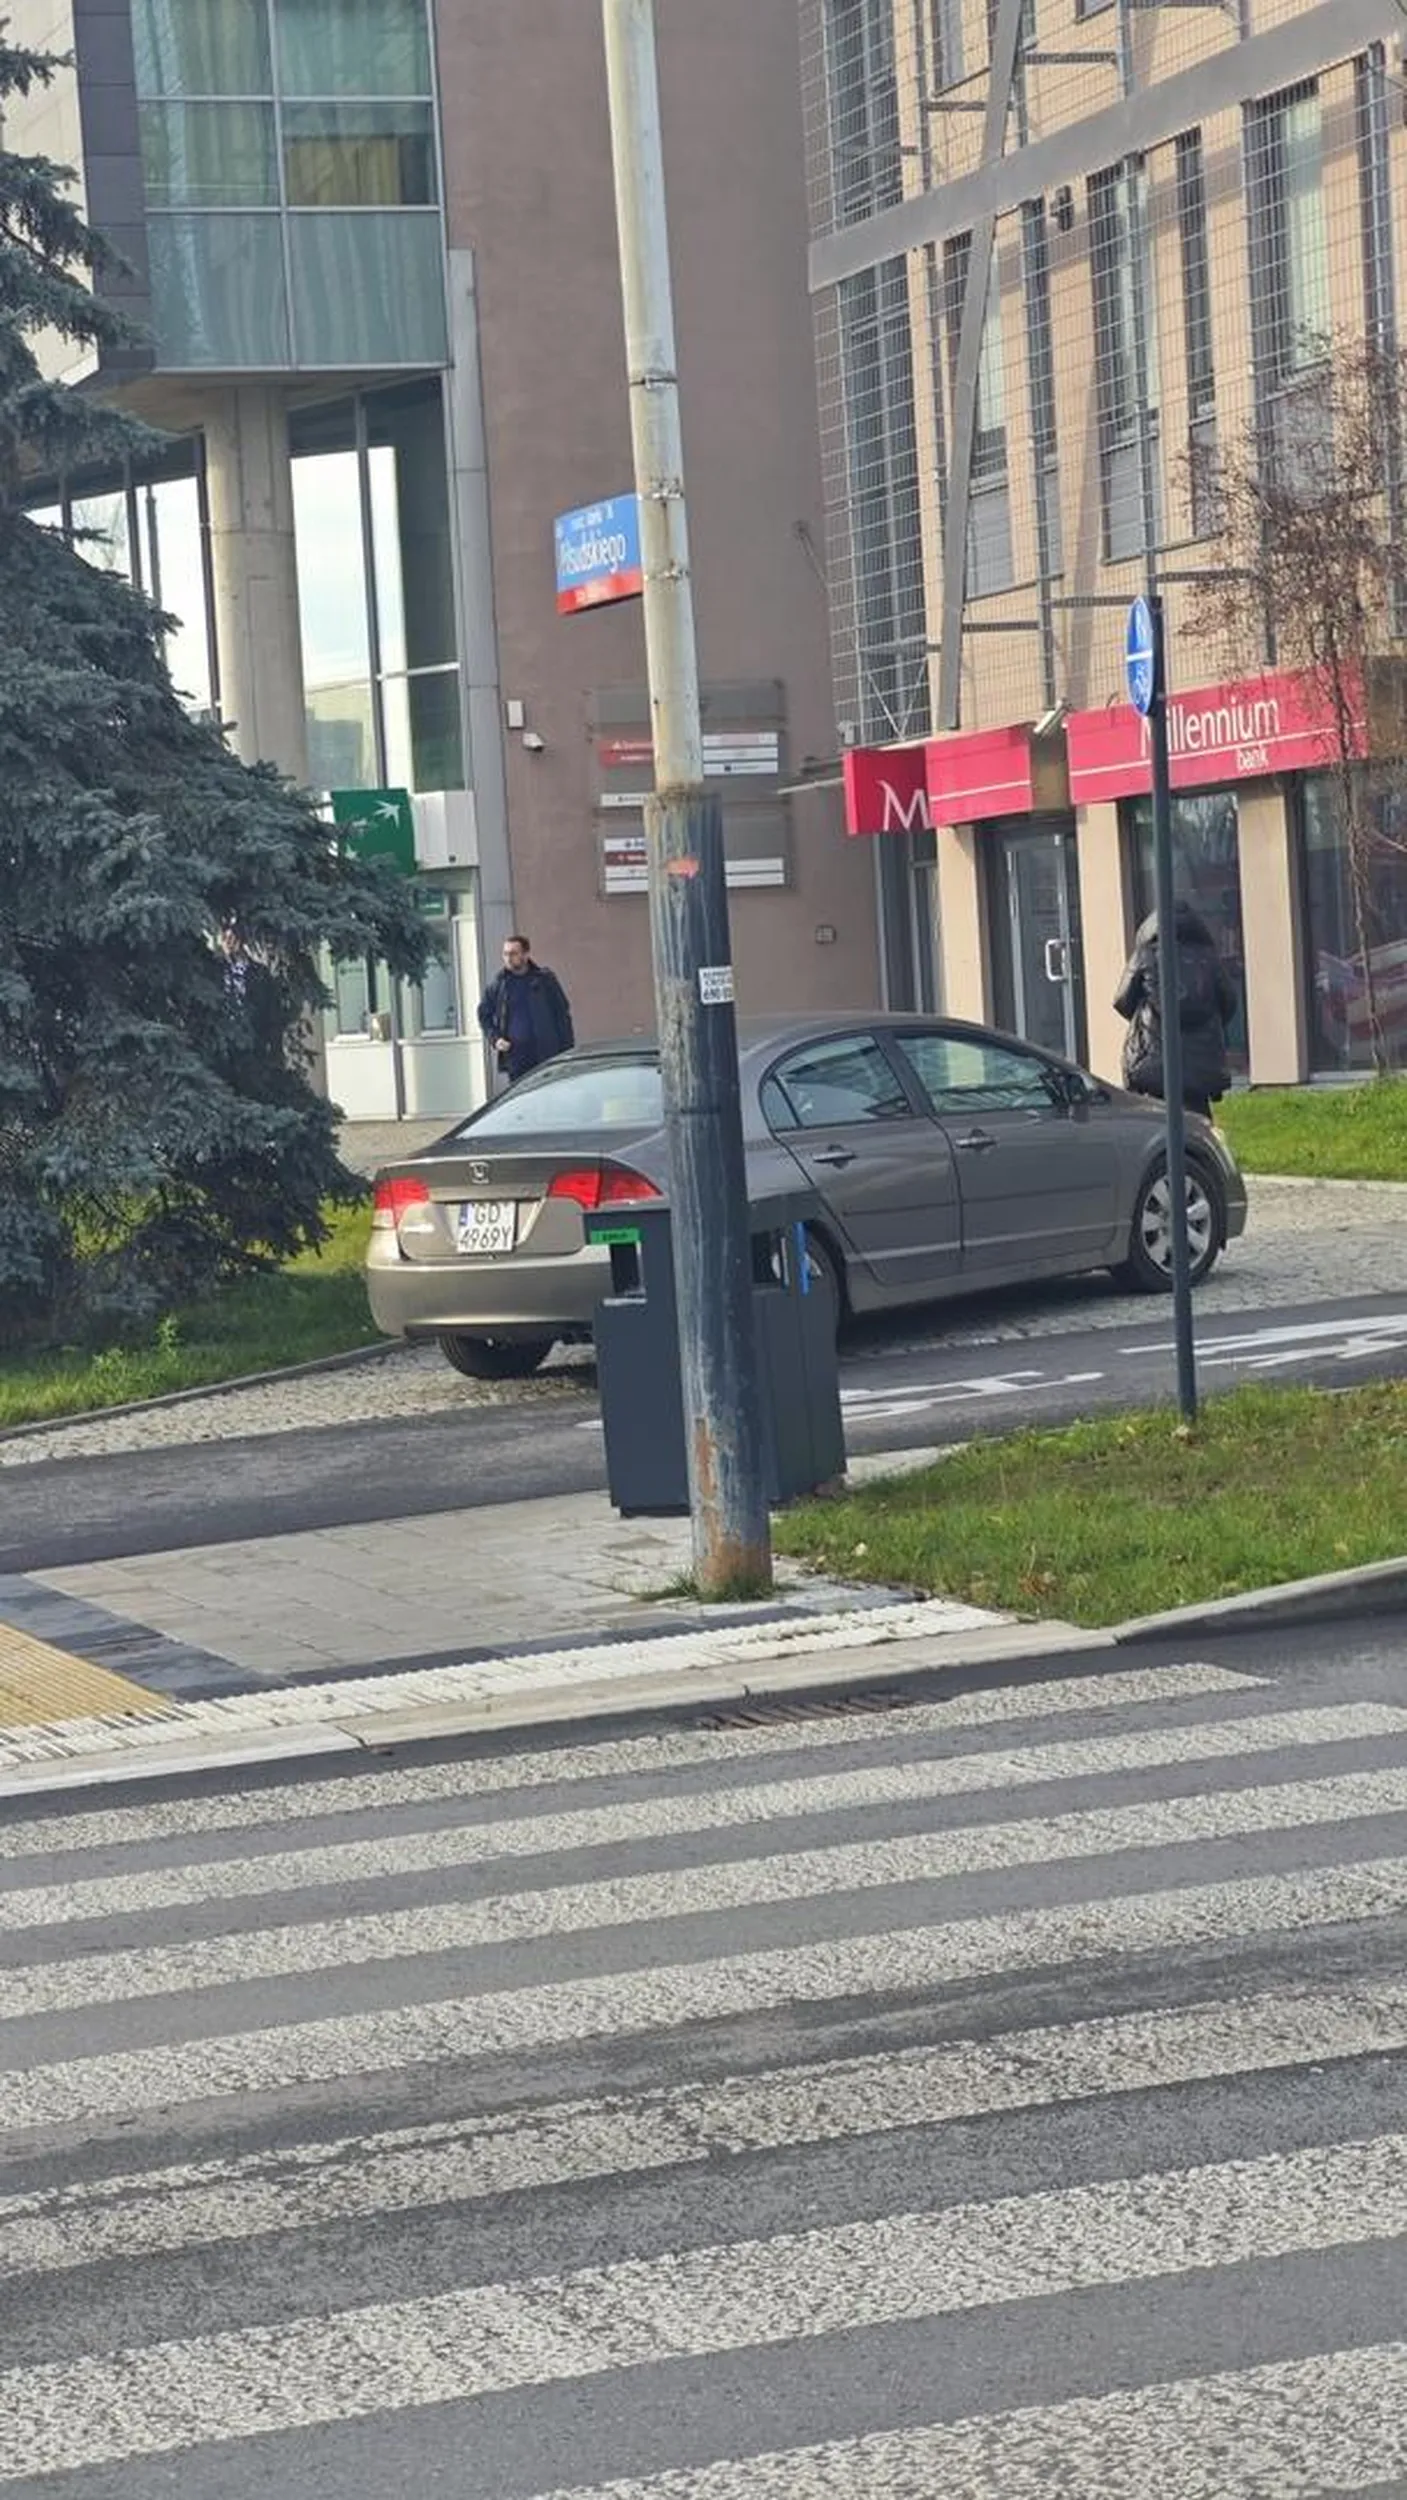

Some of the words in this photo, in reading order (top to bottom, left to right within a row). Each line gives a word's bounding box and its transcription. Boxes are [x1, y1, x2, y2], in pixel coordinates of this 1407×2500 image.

[1236, 743, 1269, 771] bank
[876, 779, 930, 832] M
[475, 1203, 501, 1224] GD
[460, 1226, 512, 1250] 4969Y
